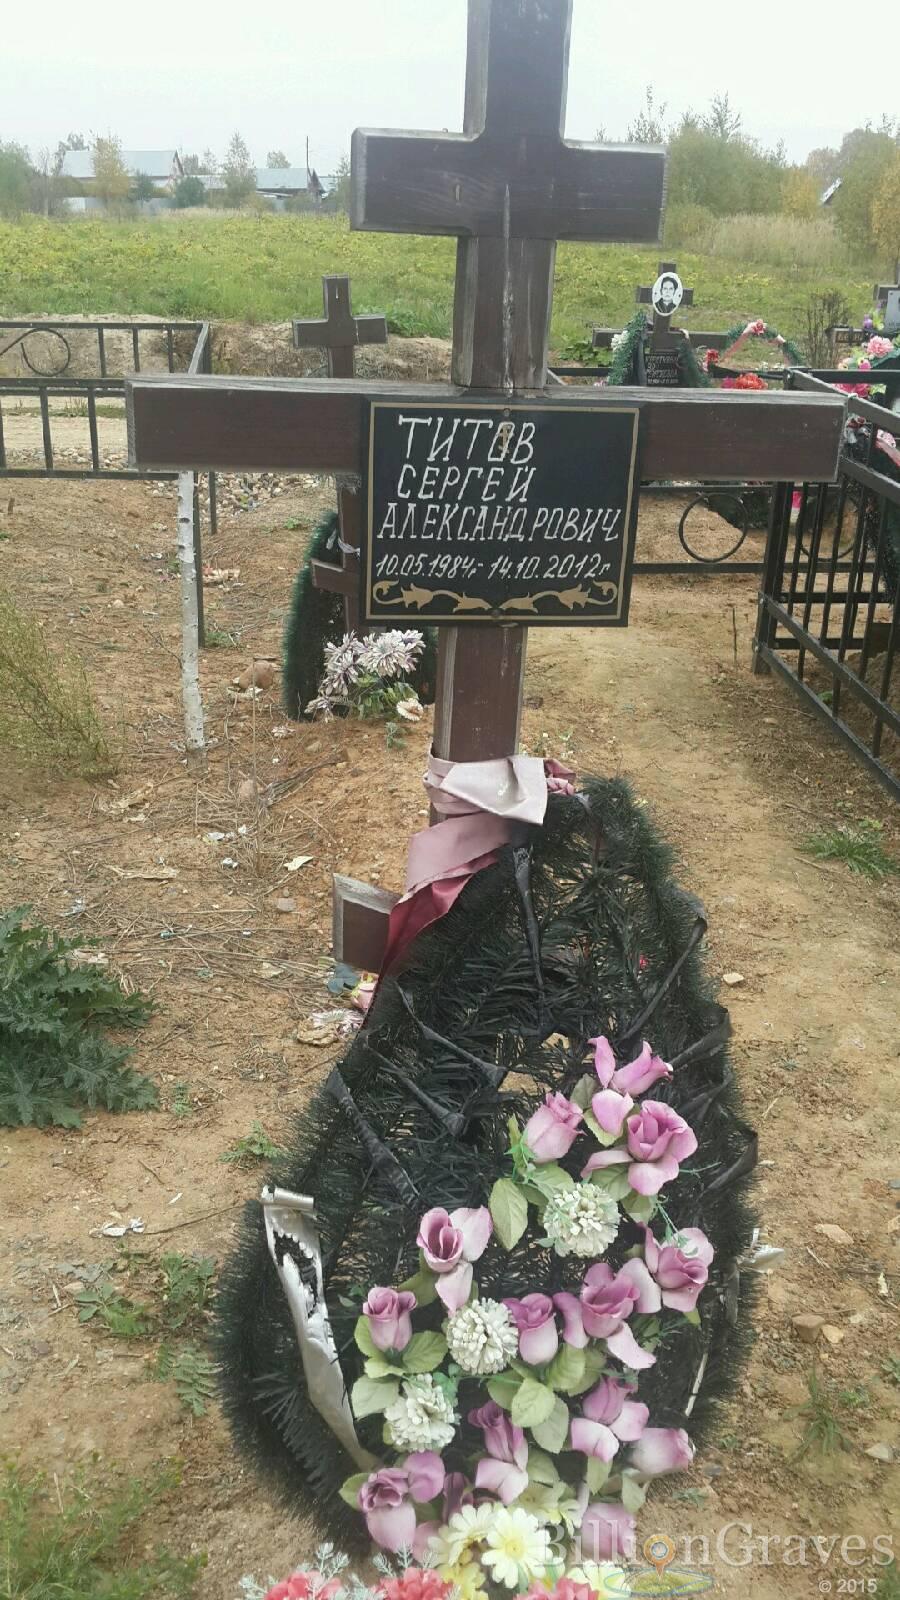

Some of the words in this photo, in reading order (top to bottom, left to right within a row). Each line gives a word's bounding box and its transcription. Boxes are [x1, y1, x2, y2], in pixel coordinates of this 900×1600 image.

[398, 415, 536, 464] ТИТОВ
[397, 464, 537, 502] СЕРГЕЙ
[377, 503, 621, 543] АЛЕКСАНДРОВИЧ
